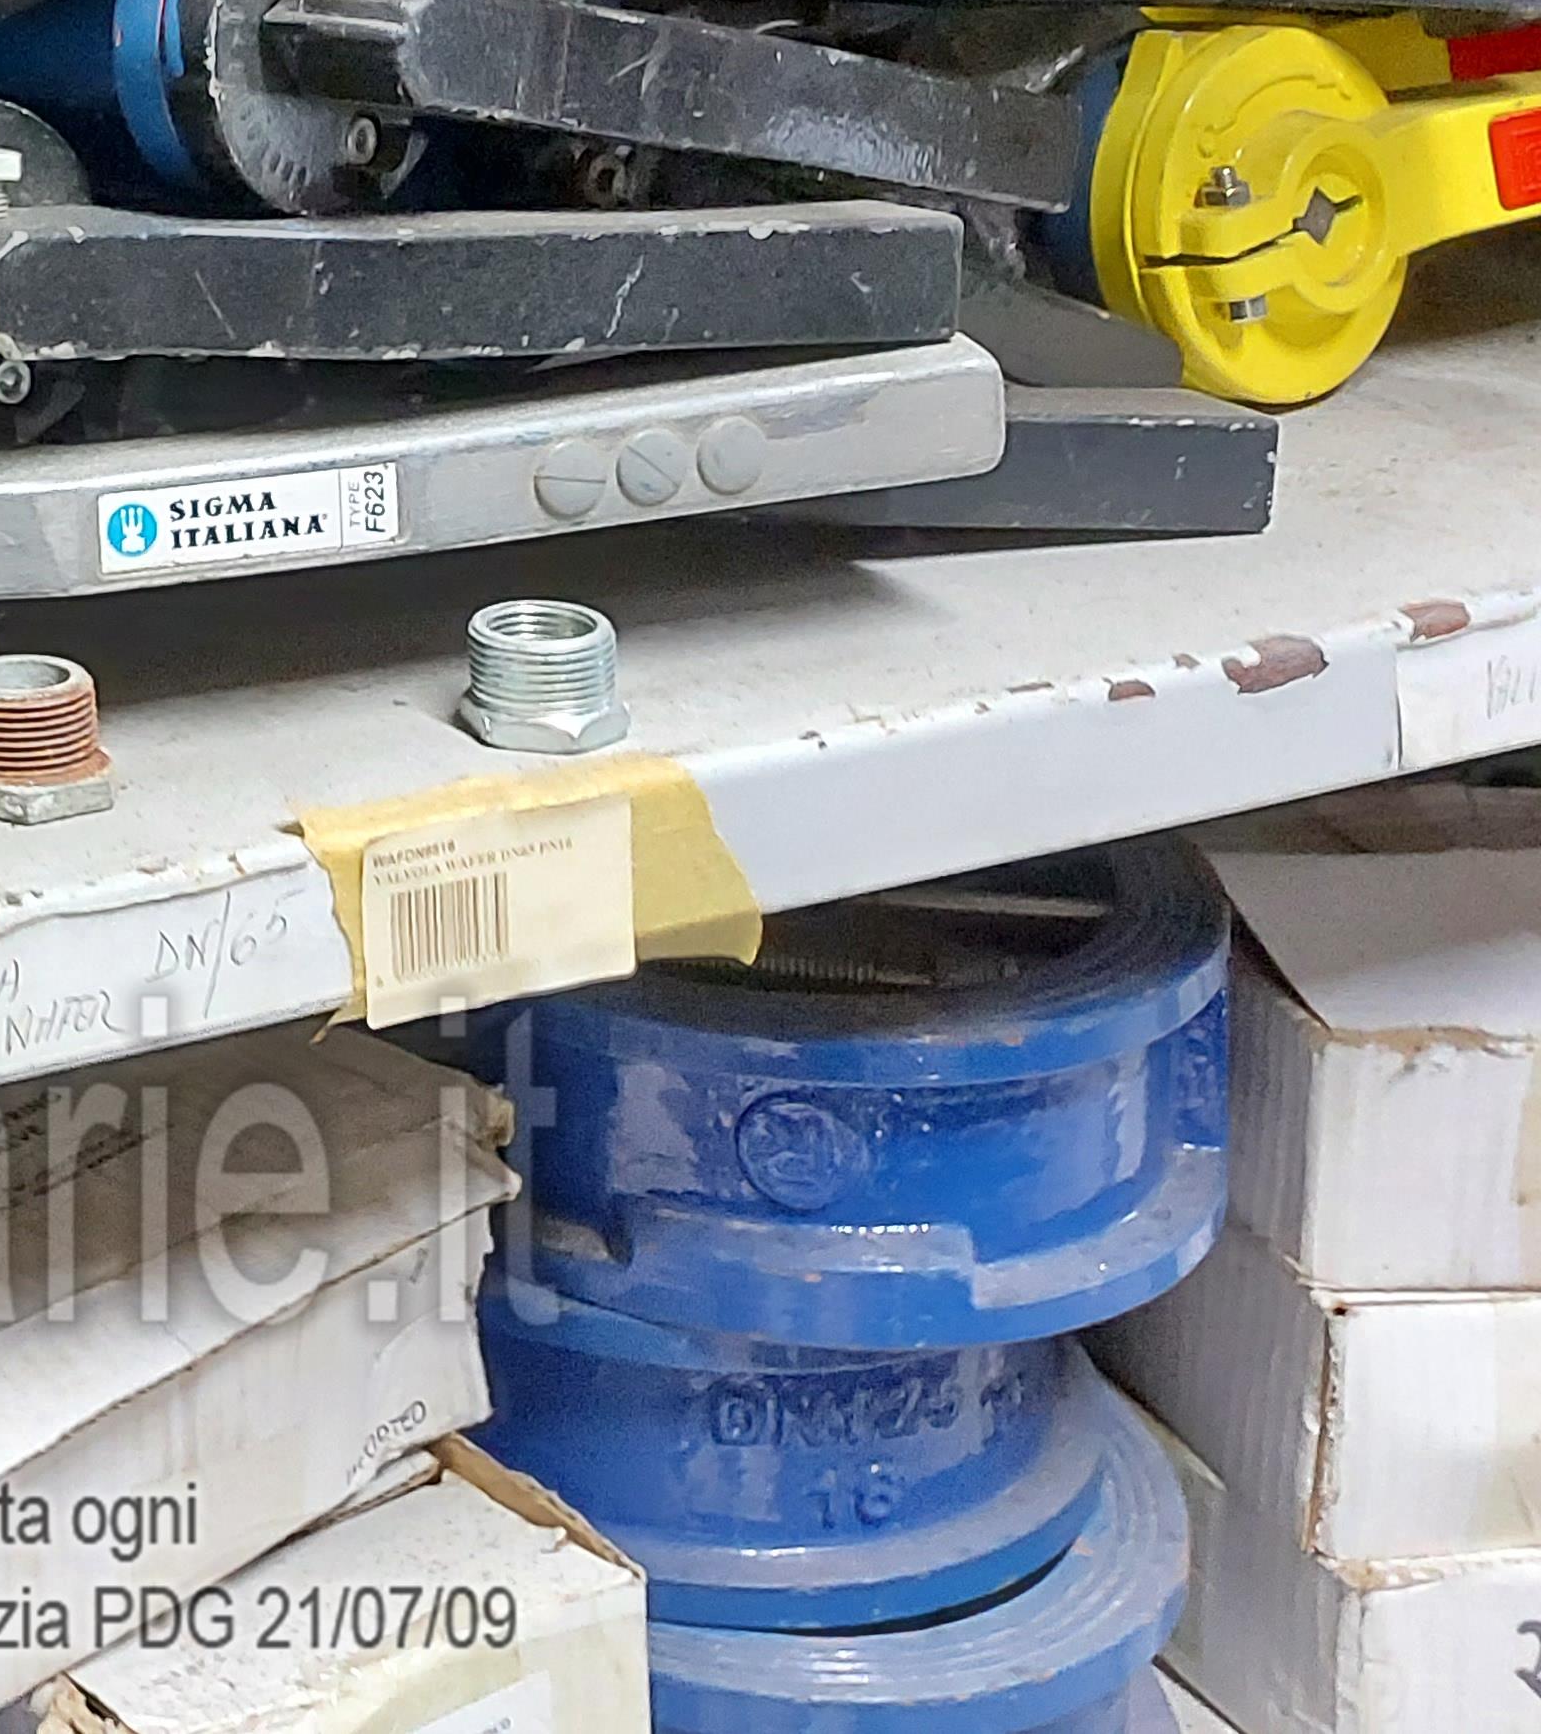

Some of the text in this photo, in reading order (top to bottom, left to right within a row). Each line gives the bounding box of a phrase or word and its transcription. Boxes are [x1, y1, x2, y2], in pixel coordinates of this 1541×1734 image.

[170, 491, 277, 522] SIGMA
[349, 480, 361, 529] TYPE
[364, 470, 386, 533] F623
